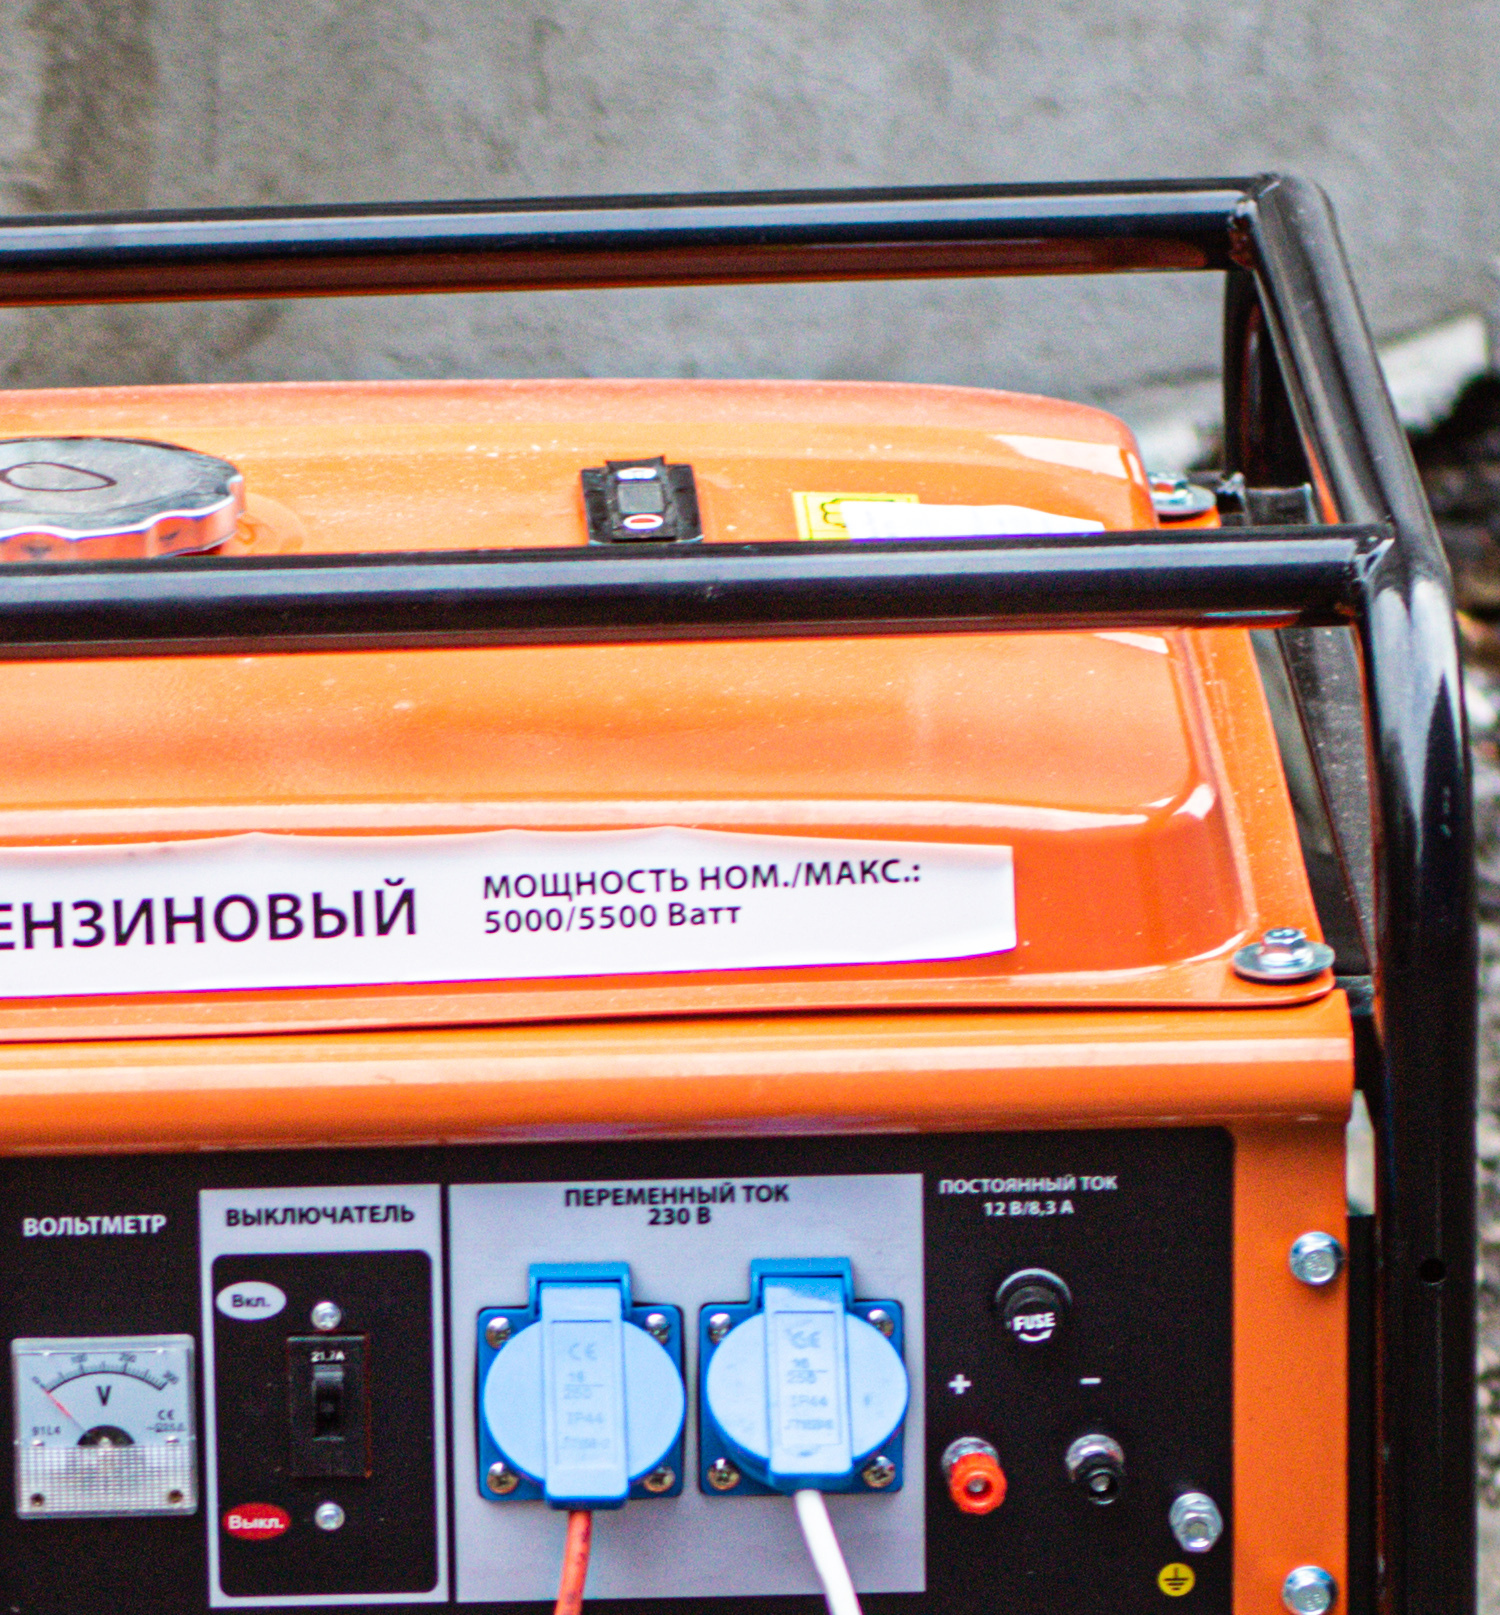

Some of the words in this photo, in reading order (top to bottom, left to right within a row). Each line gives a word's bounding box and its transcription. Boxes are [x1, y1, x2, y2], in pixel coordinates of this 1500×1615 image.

[484, 868, 688, 900] МОЩНОСТЬ
[701, 858, 919, 890] НОМ./МАКС.:
[486, 904, 656, 934] 5000/5500
[669, 902, 740, 927] Ватт
[939, 1175, 1076, 1194] ПОСТОЯННЫЙ
[1082, 1175, 1117, 1191] ТОК
[565, 1183, 735, 1207] ПЕРЕМЕННЫЙ
[742, 1184, 789, 1203] ТОК
[226, 1204, 415, 1227] ВЫКЛЮЧАТЕЛЬ
[648, 1208, 691, 1225] 230
[697, 1207, 711, 1224] В
[984, 1201, 1005, 1216] 12
[1010, 1200, 1056, 1216] В/8,3
[1060, 1200, 1074, 1214] А
[23, 1214, 166, 1237] ВОЛЬТМЕТР
[232, 1293, 270, 1309] Вкл.
[1013, 1313, 1055, 1330] FUSE
[96, 1385, 112, 1407] V
[229, 1515, 284, 1529] Выкл.
